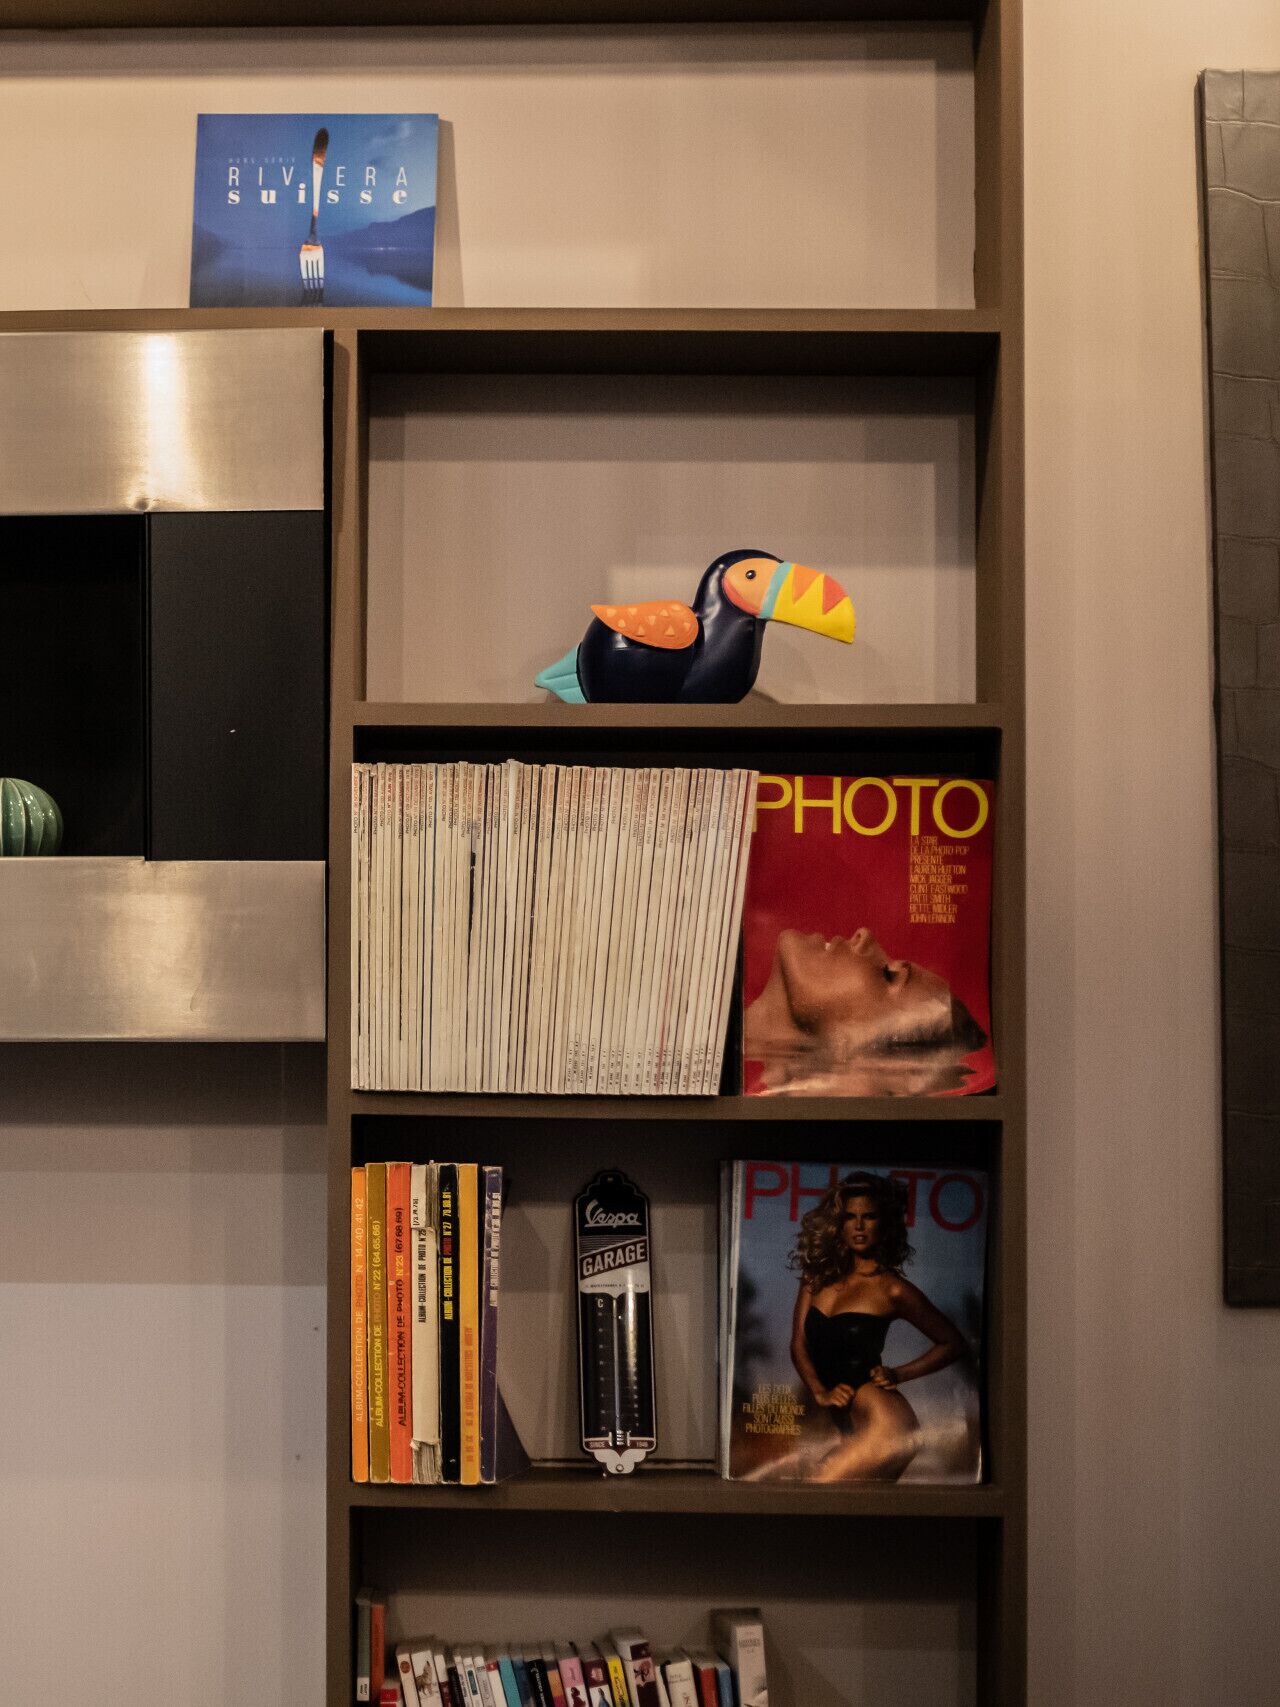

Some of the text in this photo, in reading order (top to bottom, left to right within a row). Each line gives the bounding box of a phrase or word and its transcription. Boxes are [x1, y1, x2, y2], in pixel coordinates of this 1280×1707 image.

[227, 183, 408, 205] suisse
[753, 775, 989, 839] PHOTO
[744, 1161, 984, 1232] PHTO
[584, 1199, 642, 1229] Vespa
[418, 1244, 426, 1261] PHOTO
[582, 1243, 646, 1277] GARAGE
[396, 1279, 404, 1312] PHOTO
[355, 1311, 363, 1324] DE
[374, 1324, 382, 1336] DE
[396, 1316, 405, 1328] DE
[374, 1338, 384, 1427] ALBUM-COLLECTION
[397, 1332, 406, 1426] ALBUM-COLLECTION
[589, 1440, 606, 1448] SINCE
